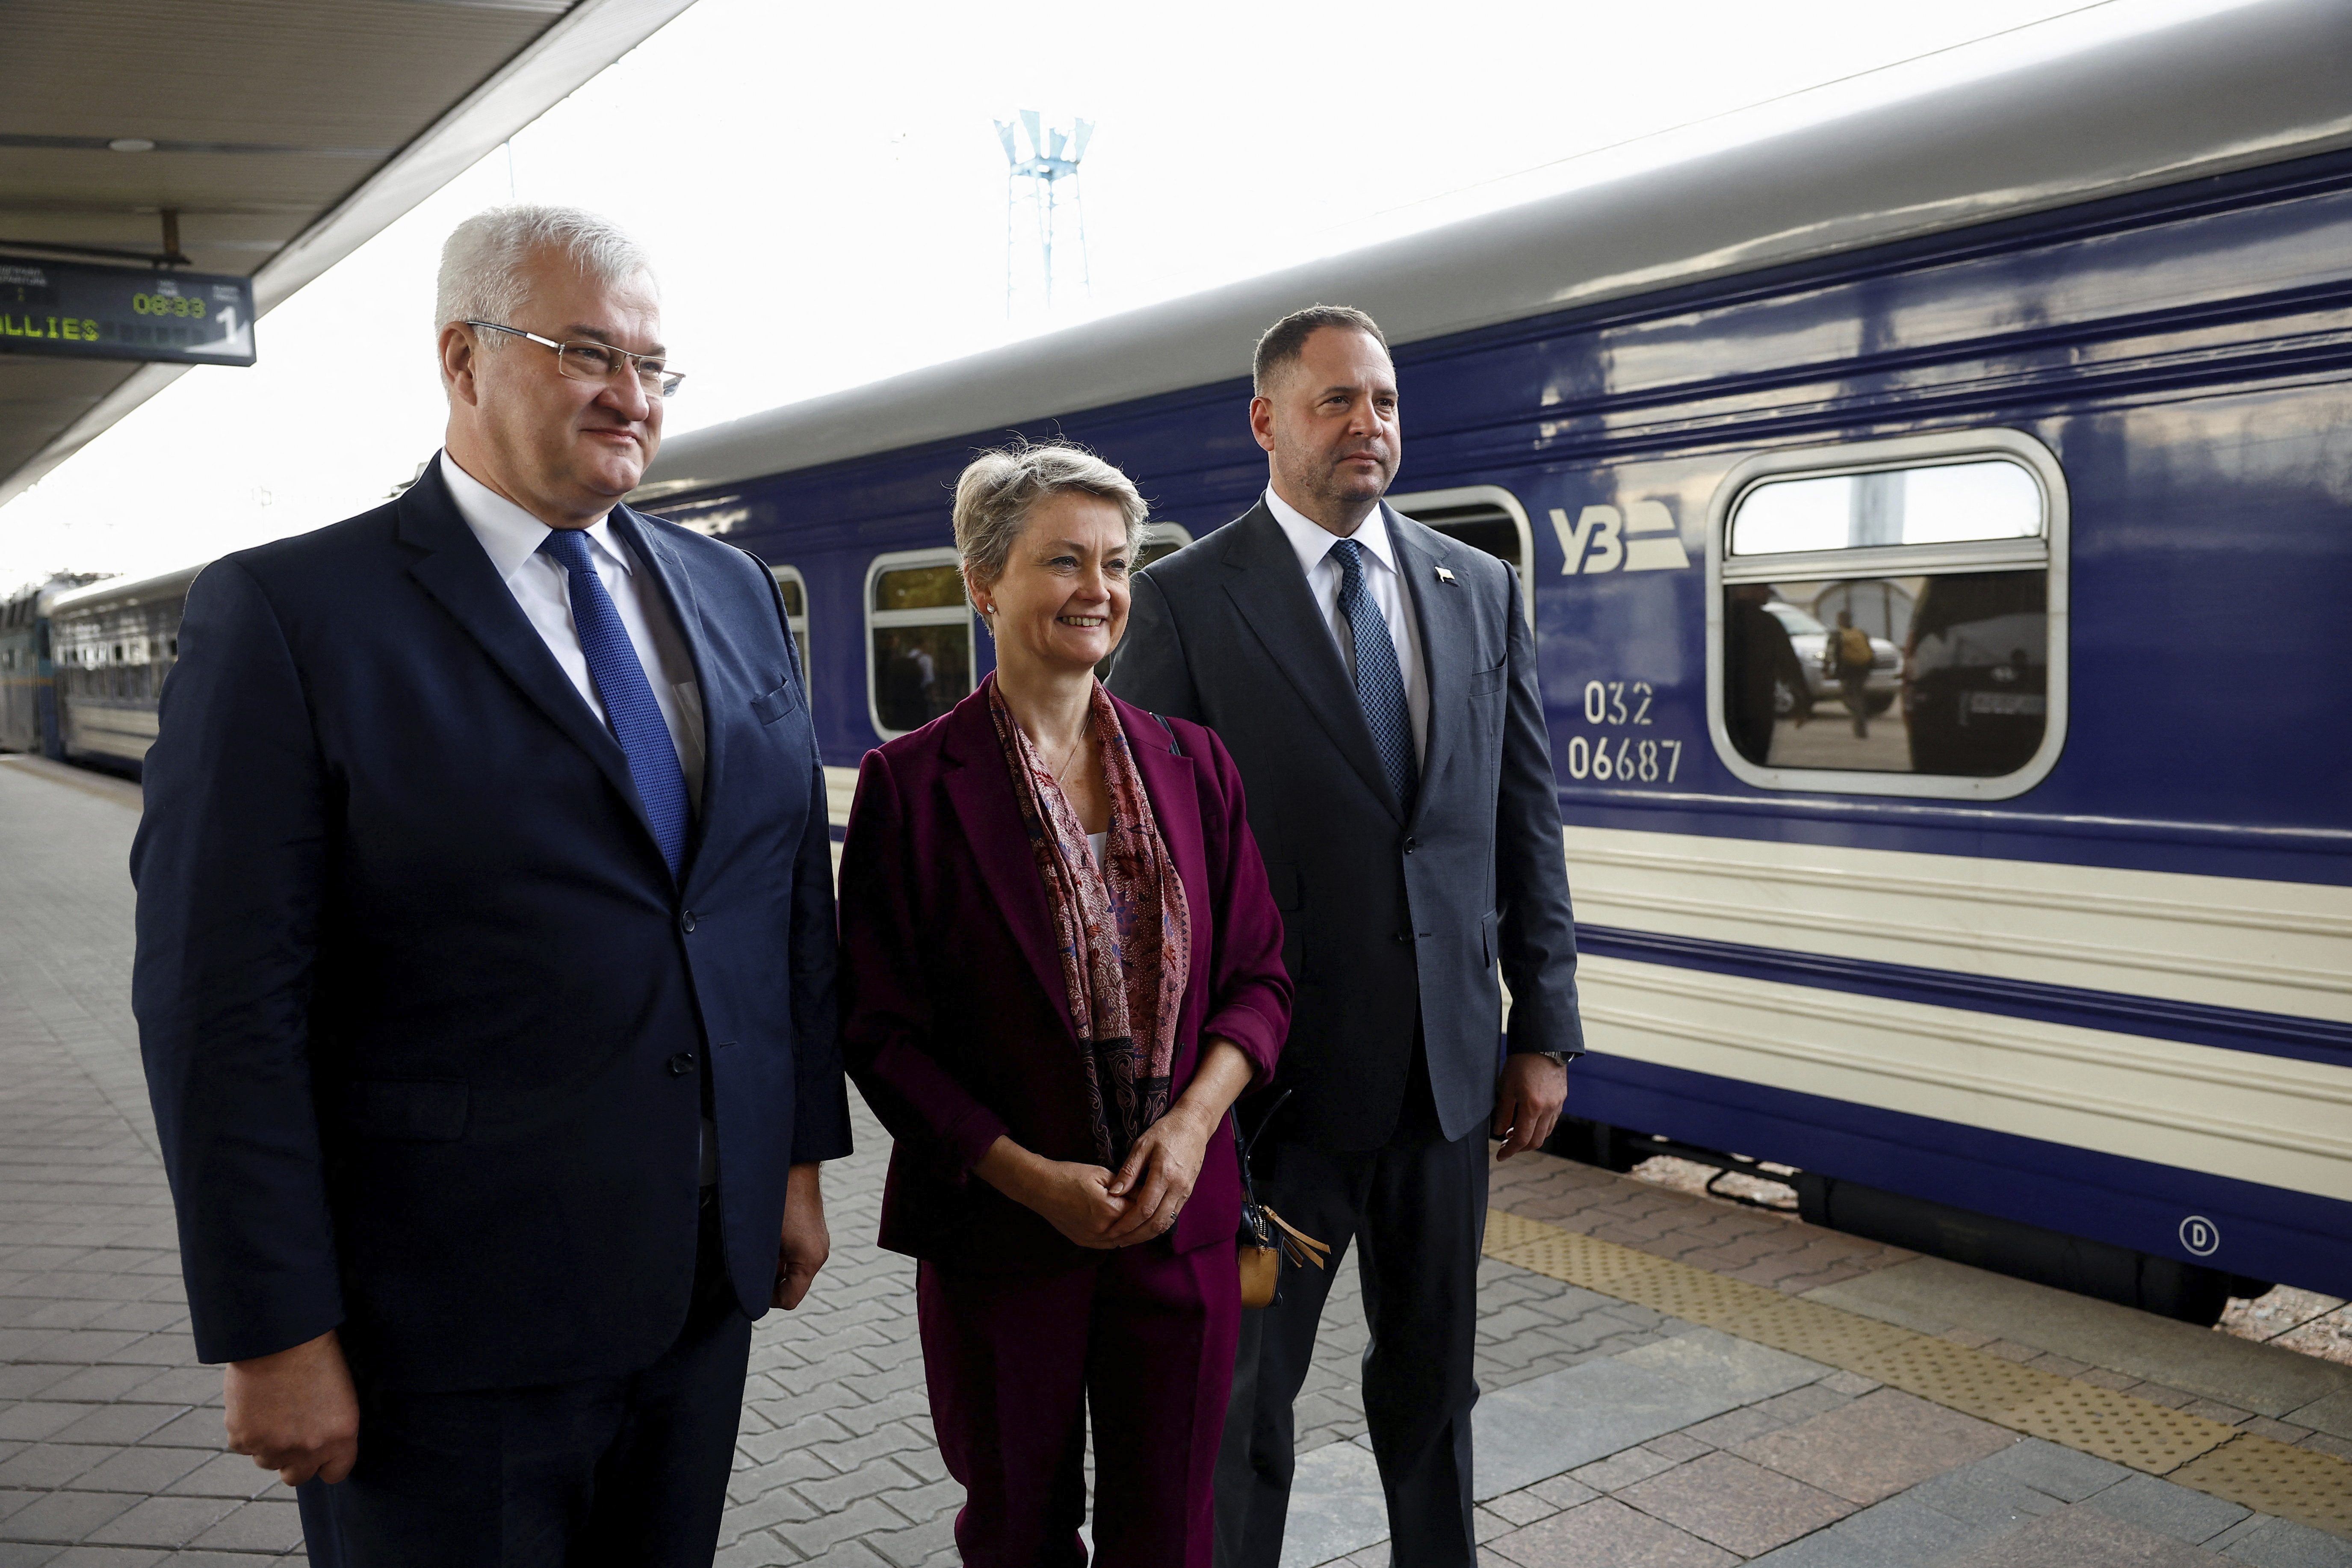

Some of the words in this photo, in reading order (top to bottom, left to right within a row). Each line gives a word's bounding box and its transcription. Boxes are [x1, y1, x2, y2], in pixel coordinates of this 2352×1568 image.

[0, 313, 99, 342] LLIES
[216, 306, 237, 344] 1
[1584, 680, 1653, 725] 032
[1568, 736, 1682, 783] 06687
[2192, 1223, 2207, 1247] D
